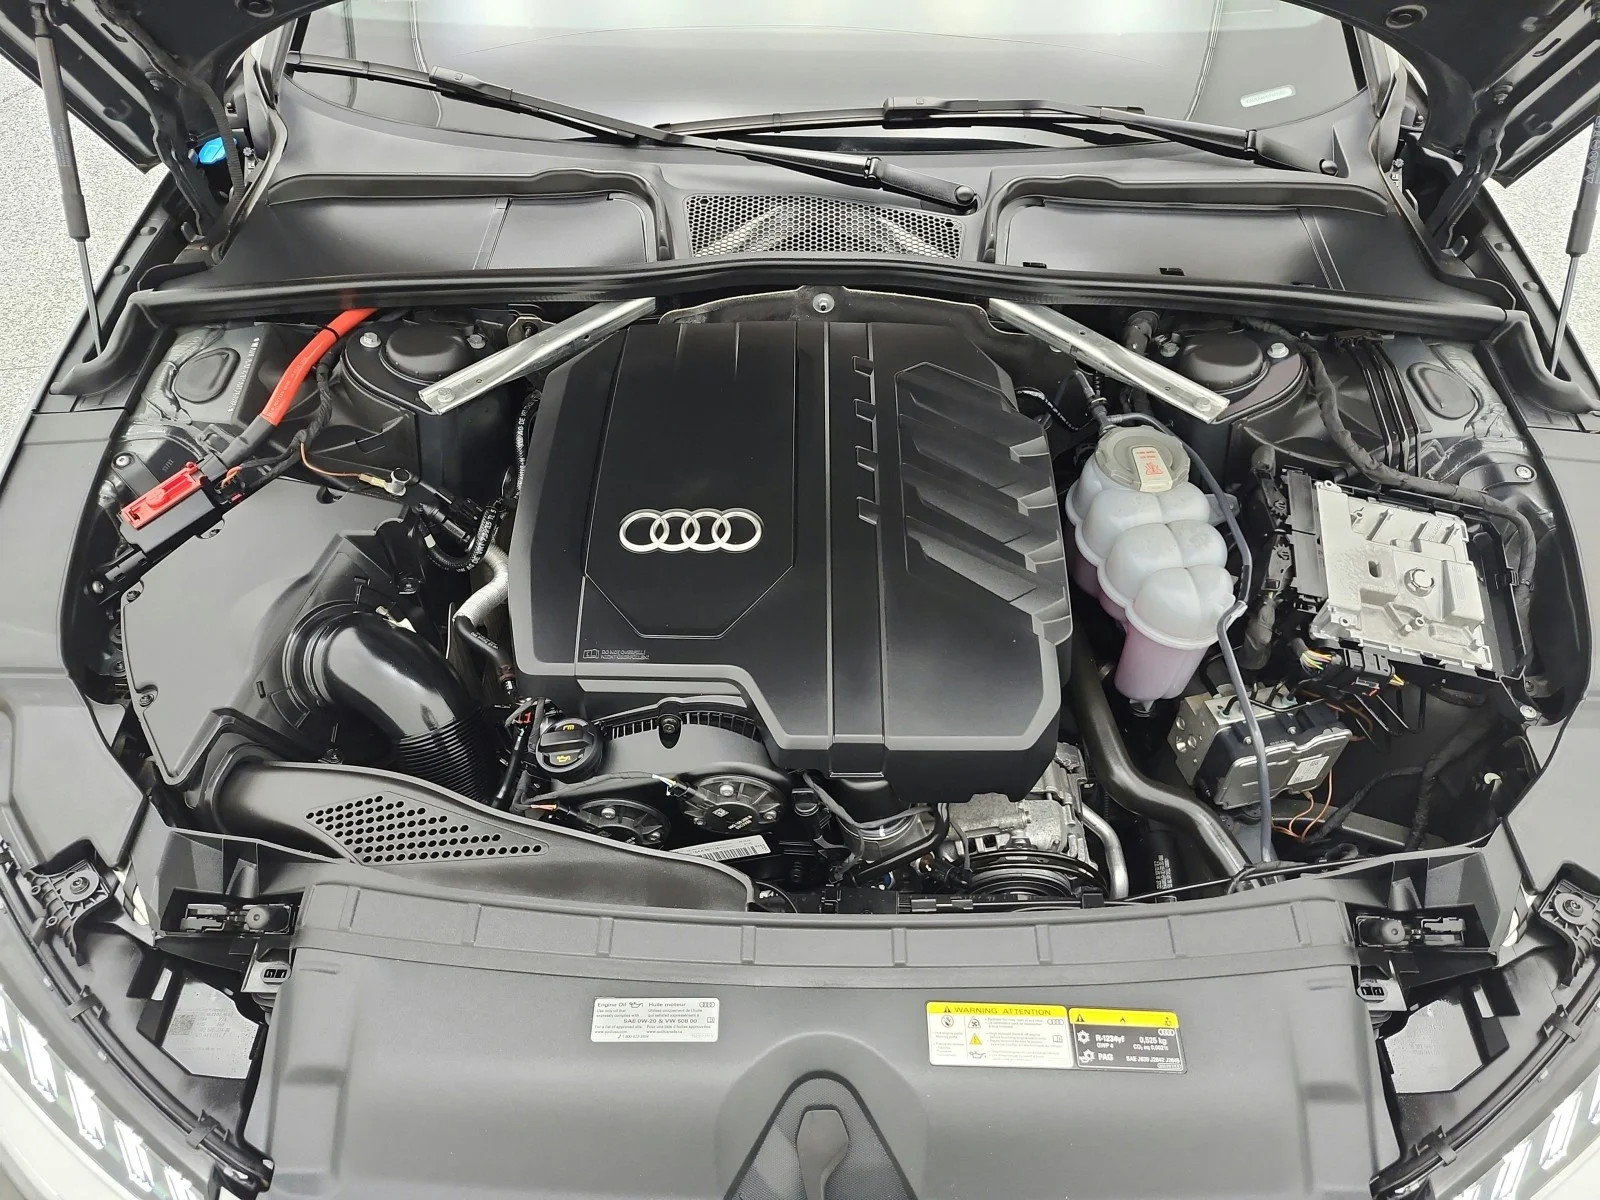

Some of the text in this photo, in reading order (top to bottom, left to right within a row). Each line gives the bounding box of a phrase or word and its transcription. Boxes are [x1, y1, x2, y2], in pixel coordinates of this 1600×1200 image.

[1002, 1008, 1052, 1016] ATTENTION
[1095, 1034, 1125, 1044] R-1234yf
[1139, 1036, 1168, 1046] 0,525 kg
[1097, 1053, 1114, 1061] PAG
